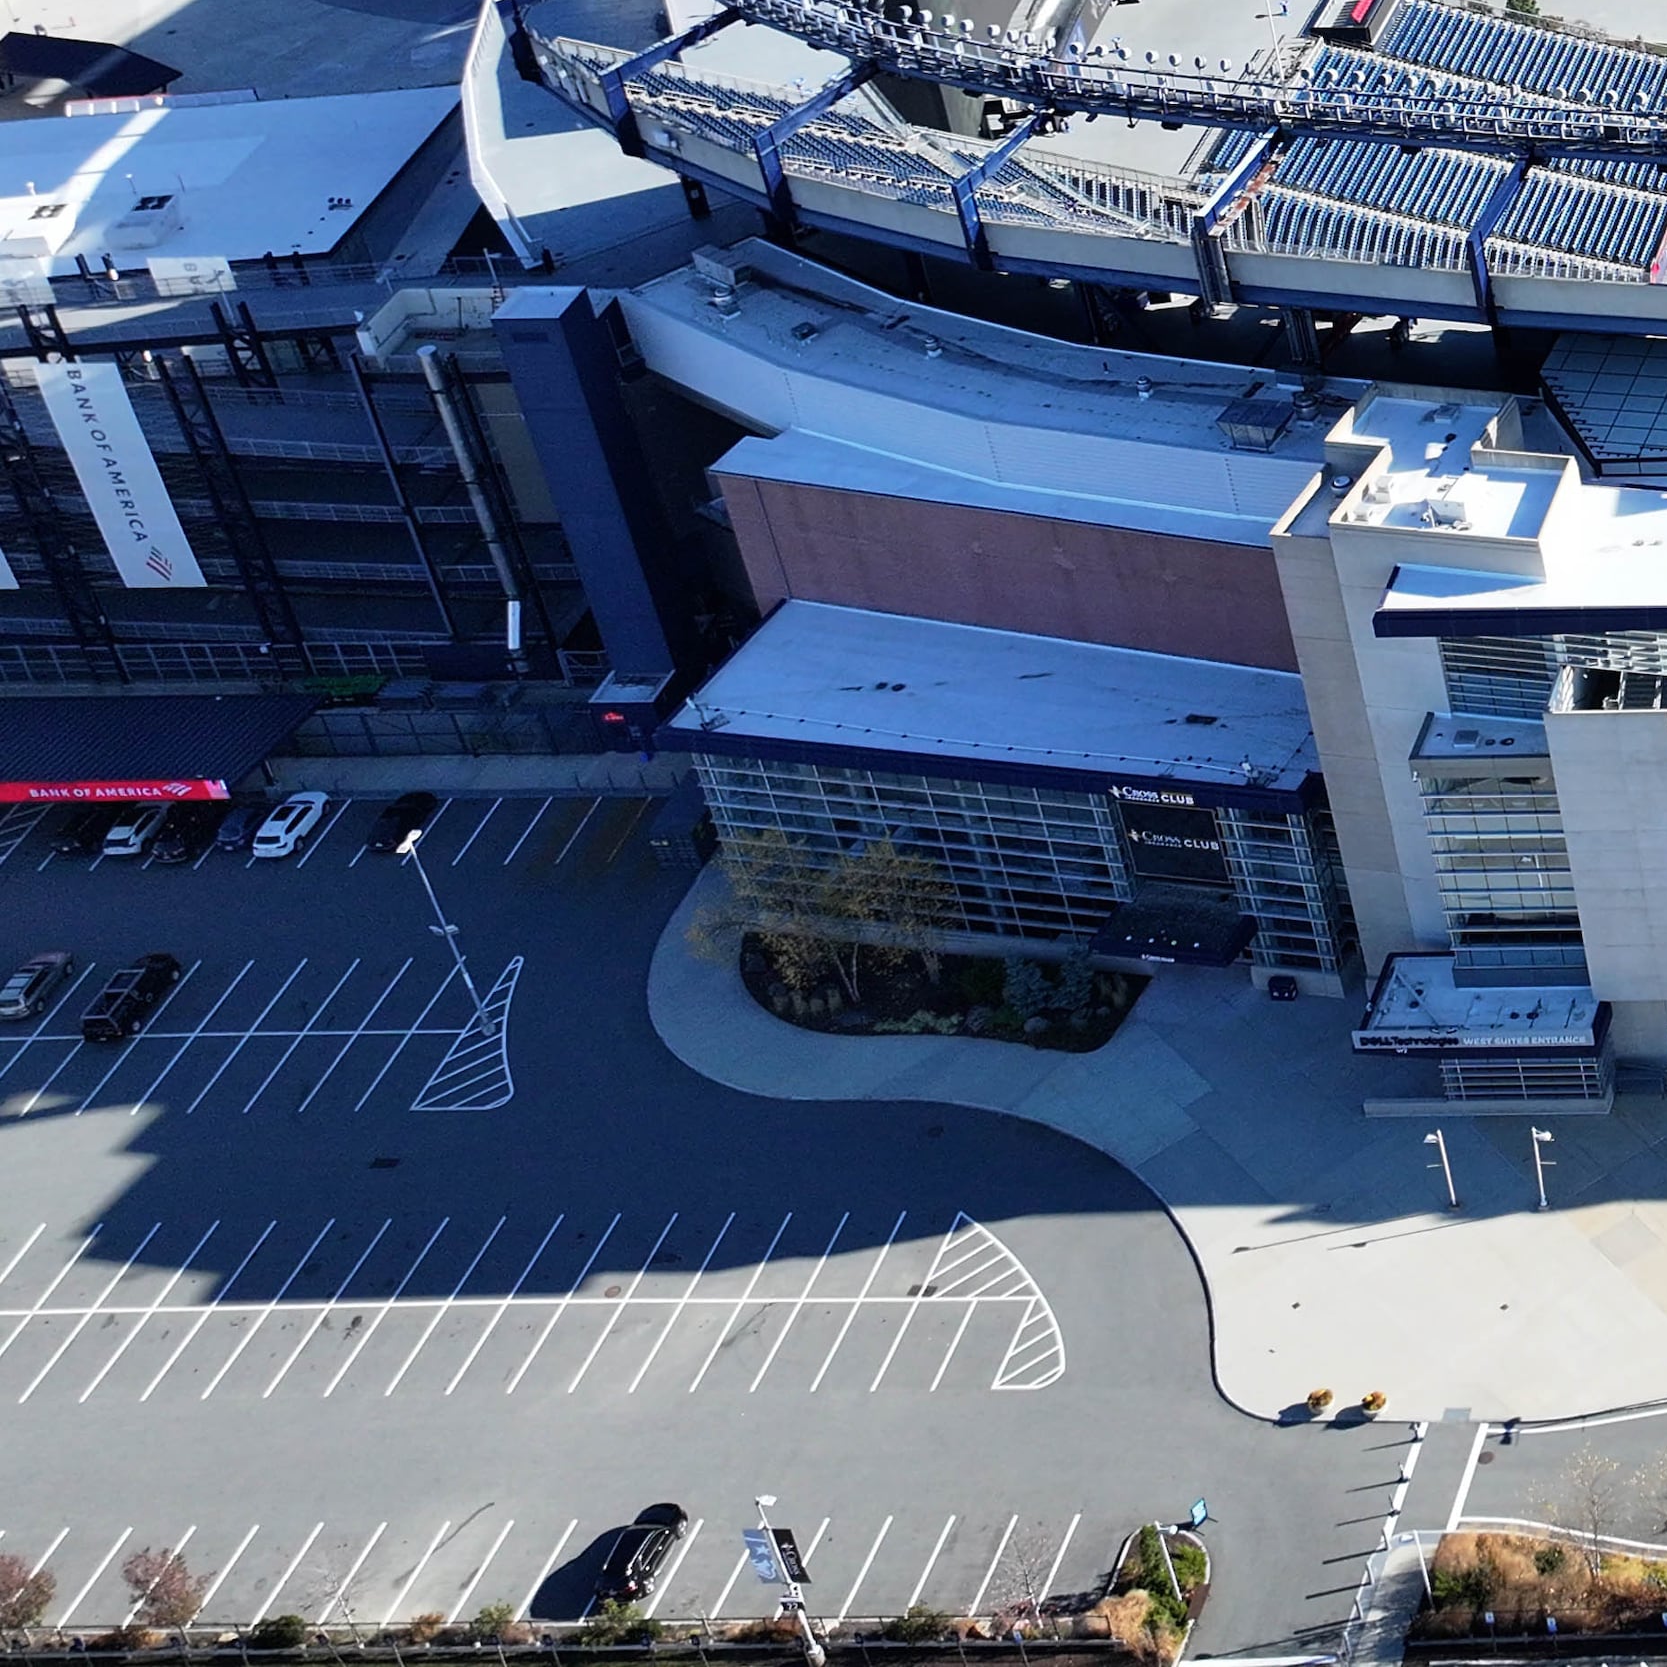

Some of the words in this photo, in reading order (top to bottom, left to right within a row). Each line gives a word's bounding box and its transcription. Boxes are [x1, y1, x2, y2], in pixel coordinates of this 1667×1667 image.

[67, 369, 99, 423] BANK
[90, 428, 113, 453] OF
[102, 456, 148, 542] AMERICA
[28, 788, 70, 798] BANK
[73, 788, 91, 798] OF
[95, 787, 162, 798] AMERICA
[1160, 794, 1195, 806] CLUB
[1183, 839, 1220, 851] CLUB
[1391, 1036, 1459, 1047] Technologies
[1462, 1037, 1492, 1046] WEST
[1494, 1037, 1530, 1046] SUITES
[1532, 1036, 1586, 1045] ENTRANCE
